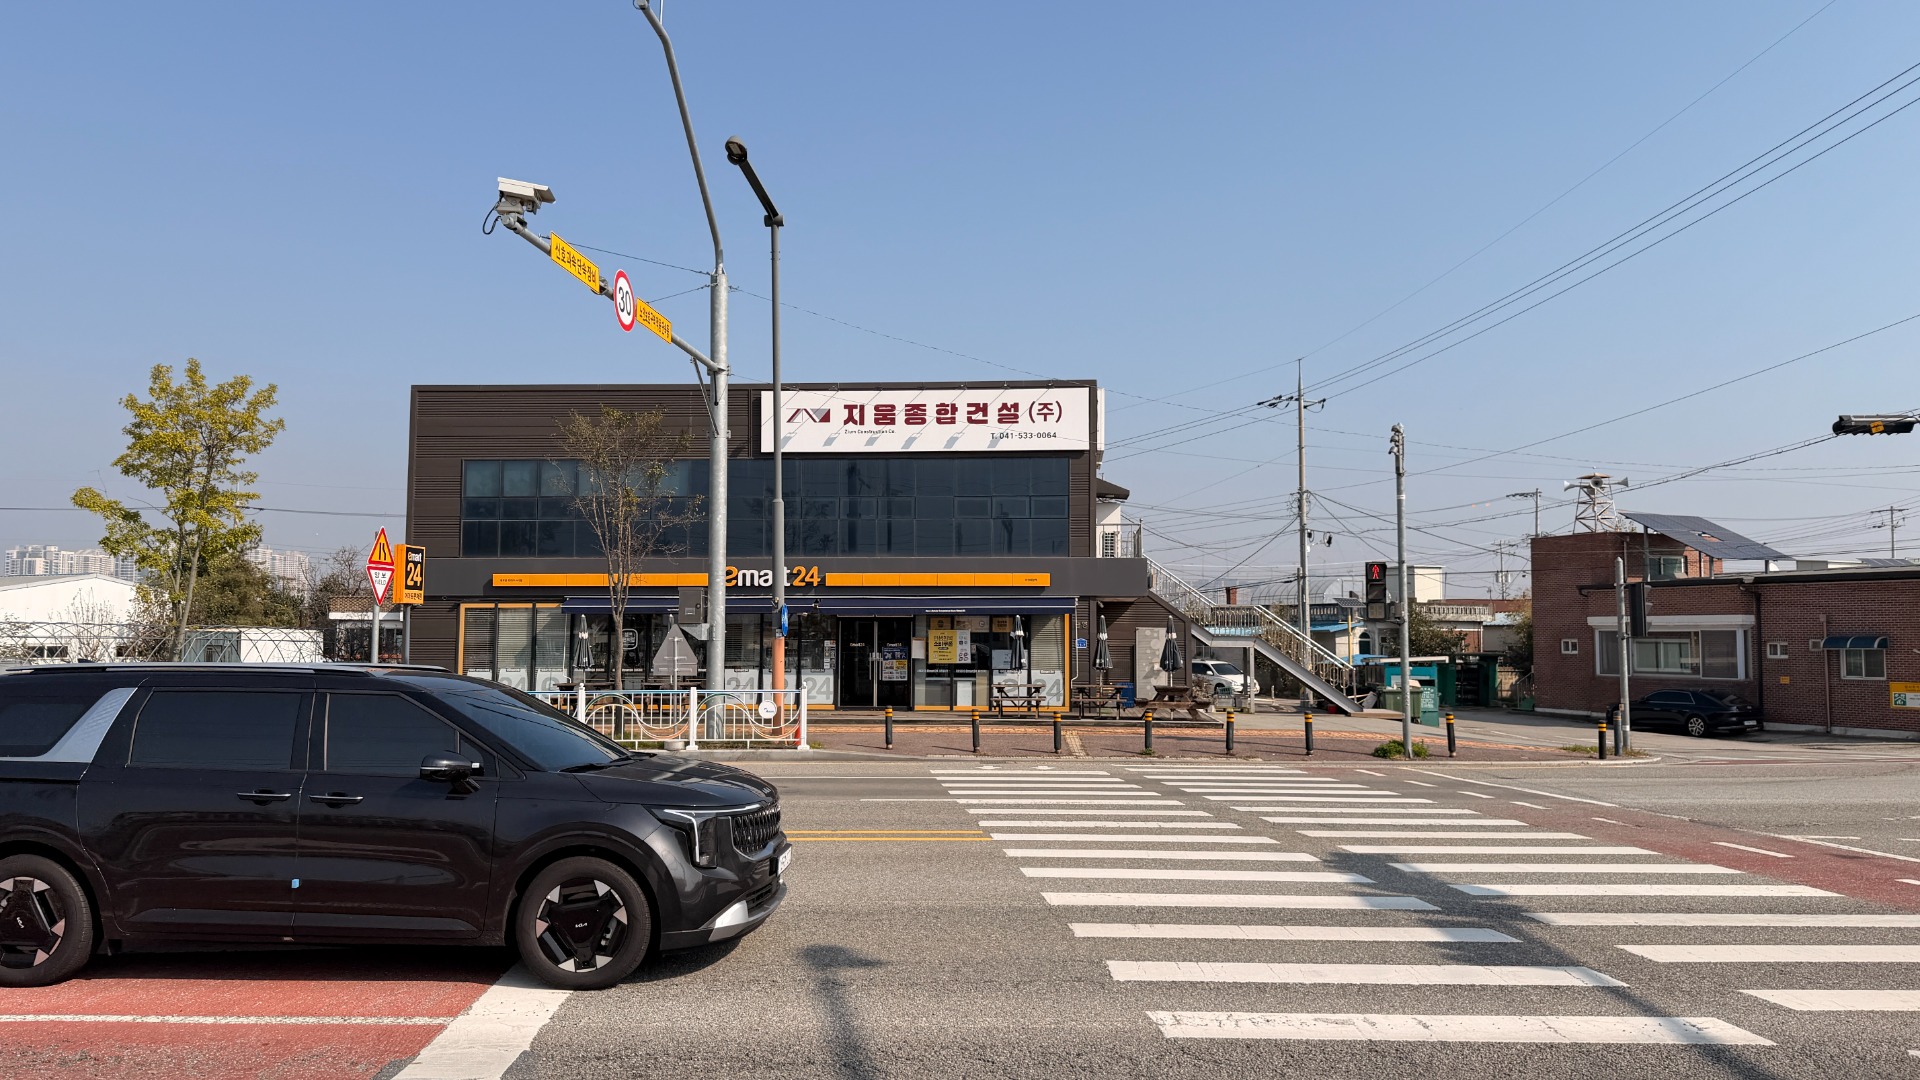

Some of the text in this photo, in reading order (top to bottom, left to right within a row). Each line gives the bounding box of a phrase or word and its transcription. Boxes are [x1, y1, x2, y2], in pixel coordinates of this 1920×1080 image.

[554, 242, 597, 287] 신호과속단속장비
[618, 286, 632, 317] 30
[406, 562, 423, 587] 24
[725, 565, 822, 587] emat24
[802, 676, 833, 701] 24
